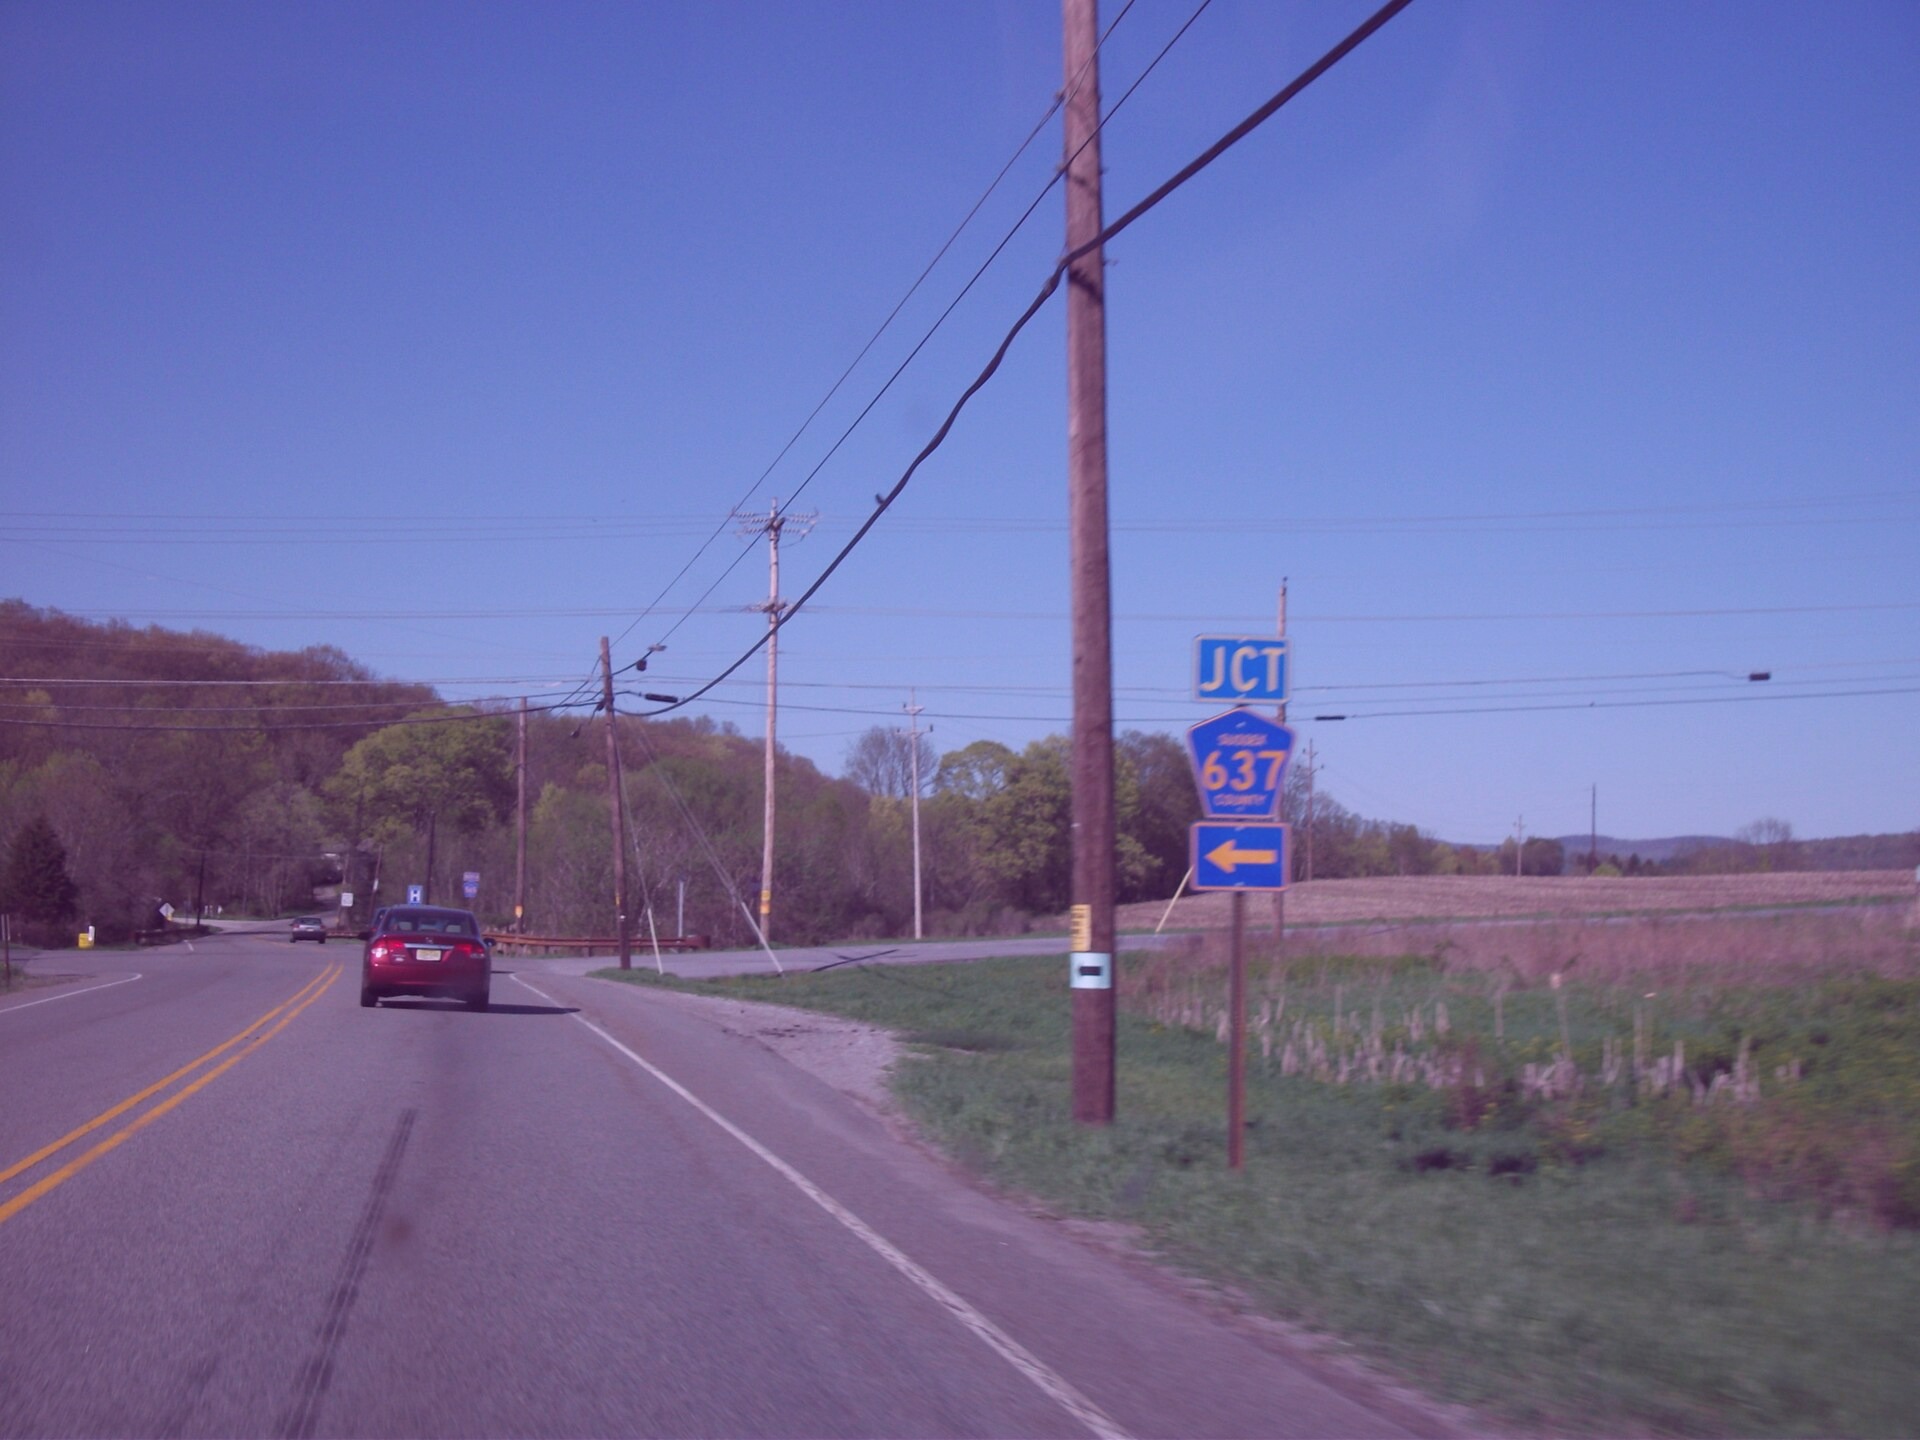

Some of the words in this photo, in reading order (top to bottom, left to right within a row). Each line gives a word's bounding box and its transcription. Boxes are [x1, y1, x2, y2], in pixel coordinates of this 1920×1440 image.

[1200, 646, 1286, 692] JCT
[1202, 750, 1286, 791] 637
[410, 889, 421, 903] H
